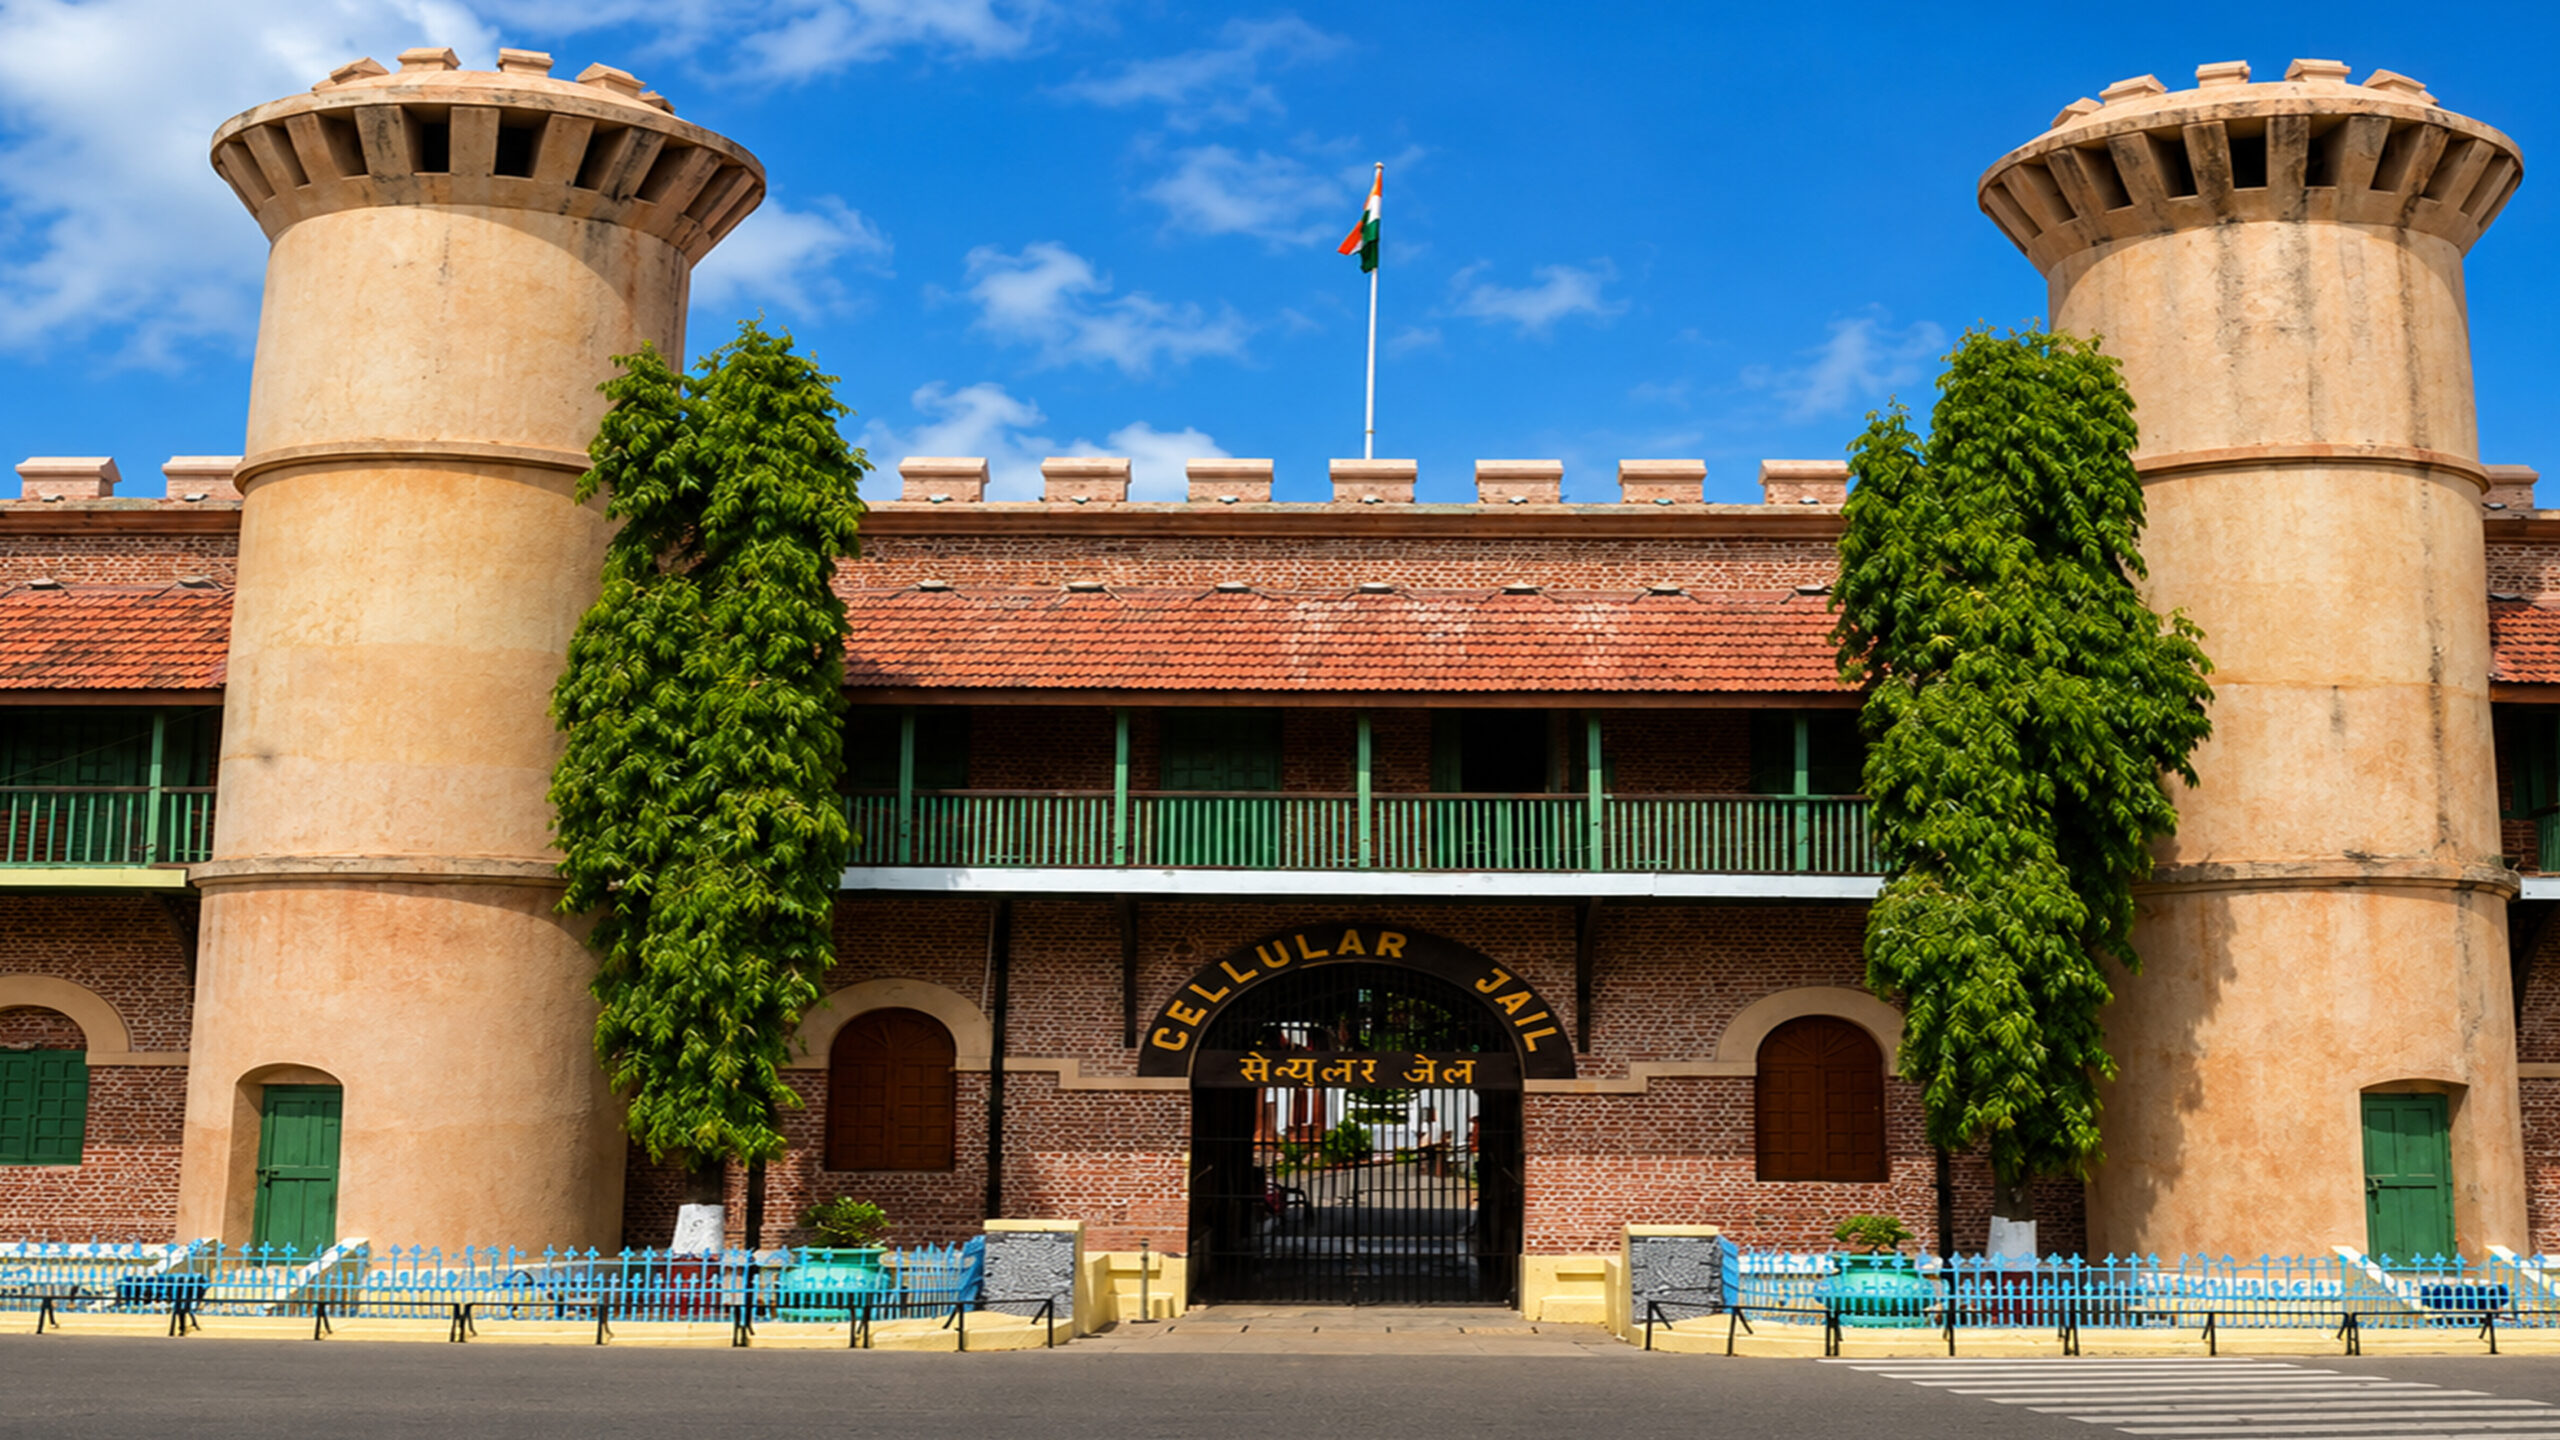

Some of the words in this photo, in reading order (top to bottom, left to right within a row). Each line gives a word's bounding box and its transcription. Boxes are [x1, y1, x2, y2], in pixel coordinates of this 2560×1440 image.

[1151, 929, 1407, 1052] CELLULAR
[1474, 967, 1558, 1053] JAIL
[1402, 1053, 1478, 1085] जेल
